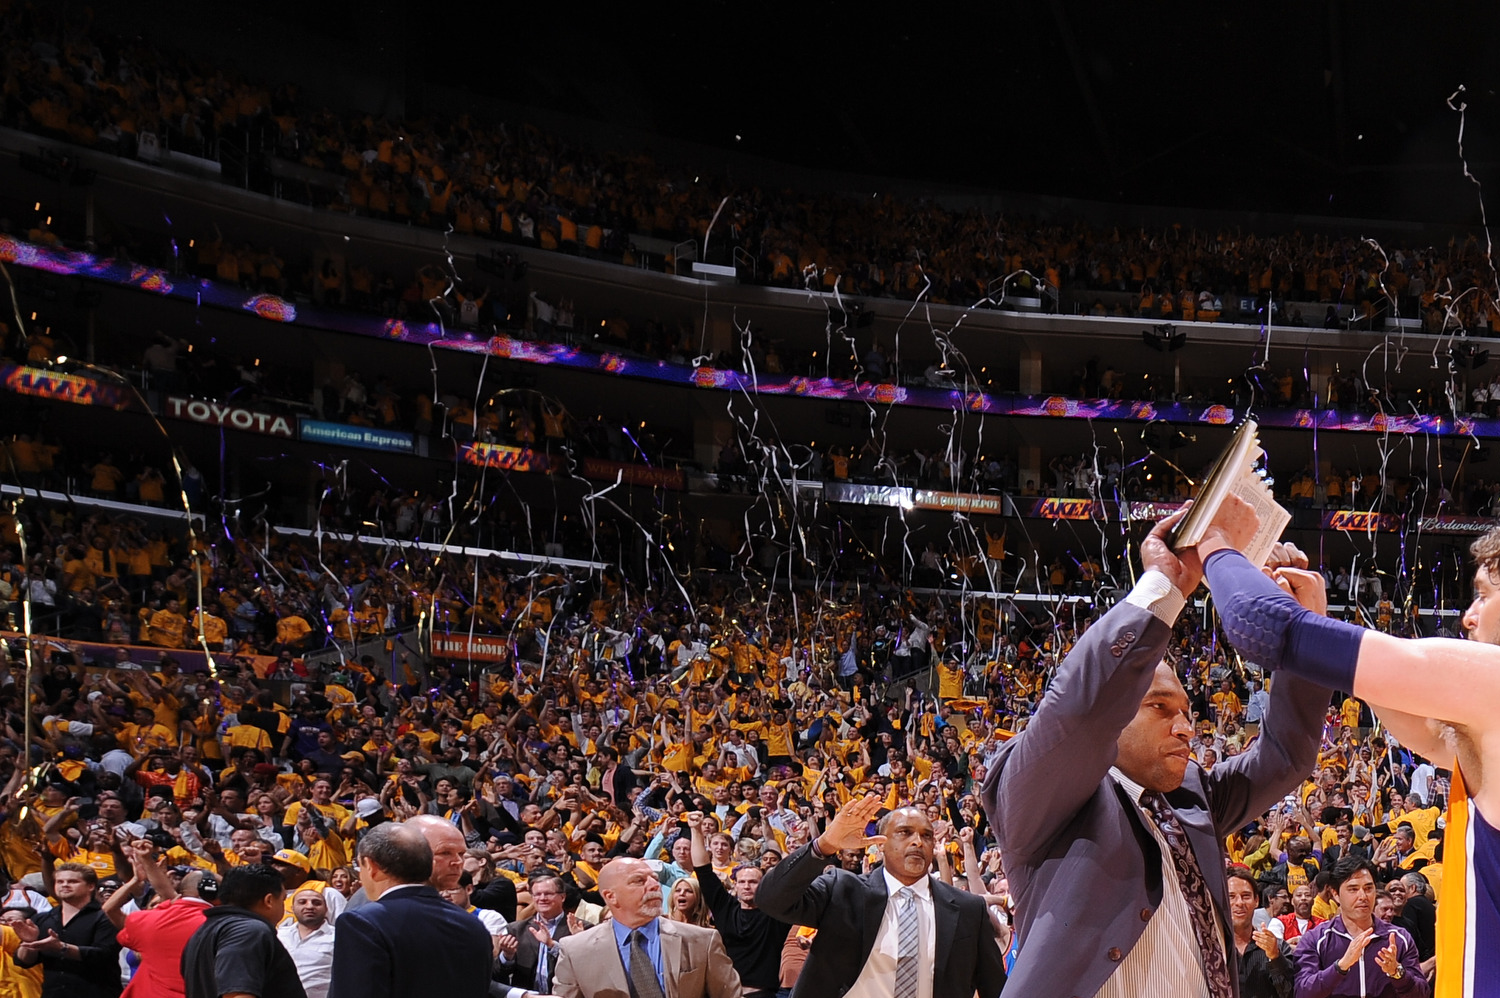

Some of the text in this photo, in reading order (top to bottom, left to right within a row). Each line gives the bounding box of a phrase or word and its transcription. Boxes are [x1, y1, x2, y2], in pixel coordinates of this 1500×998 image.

[168, 397, 293, 436] TOYOTA
[303, 424, 413, 448] American Express
[1422, 516, 1495, 532] Budweiser
[433, 639, 463, 652] THE
